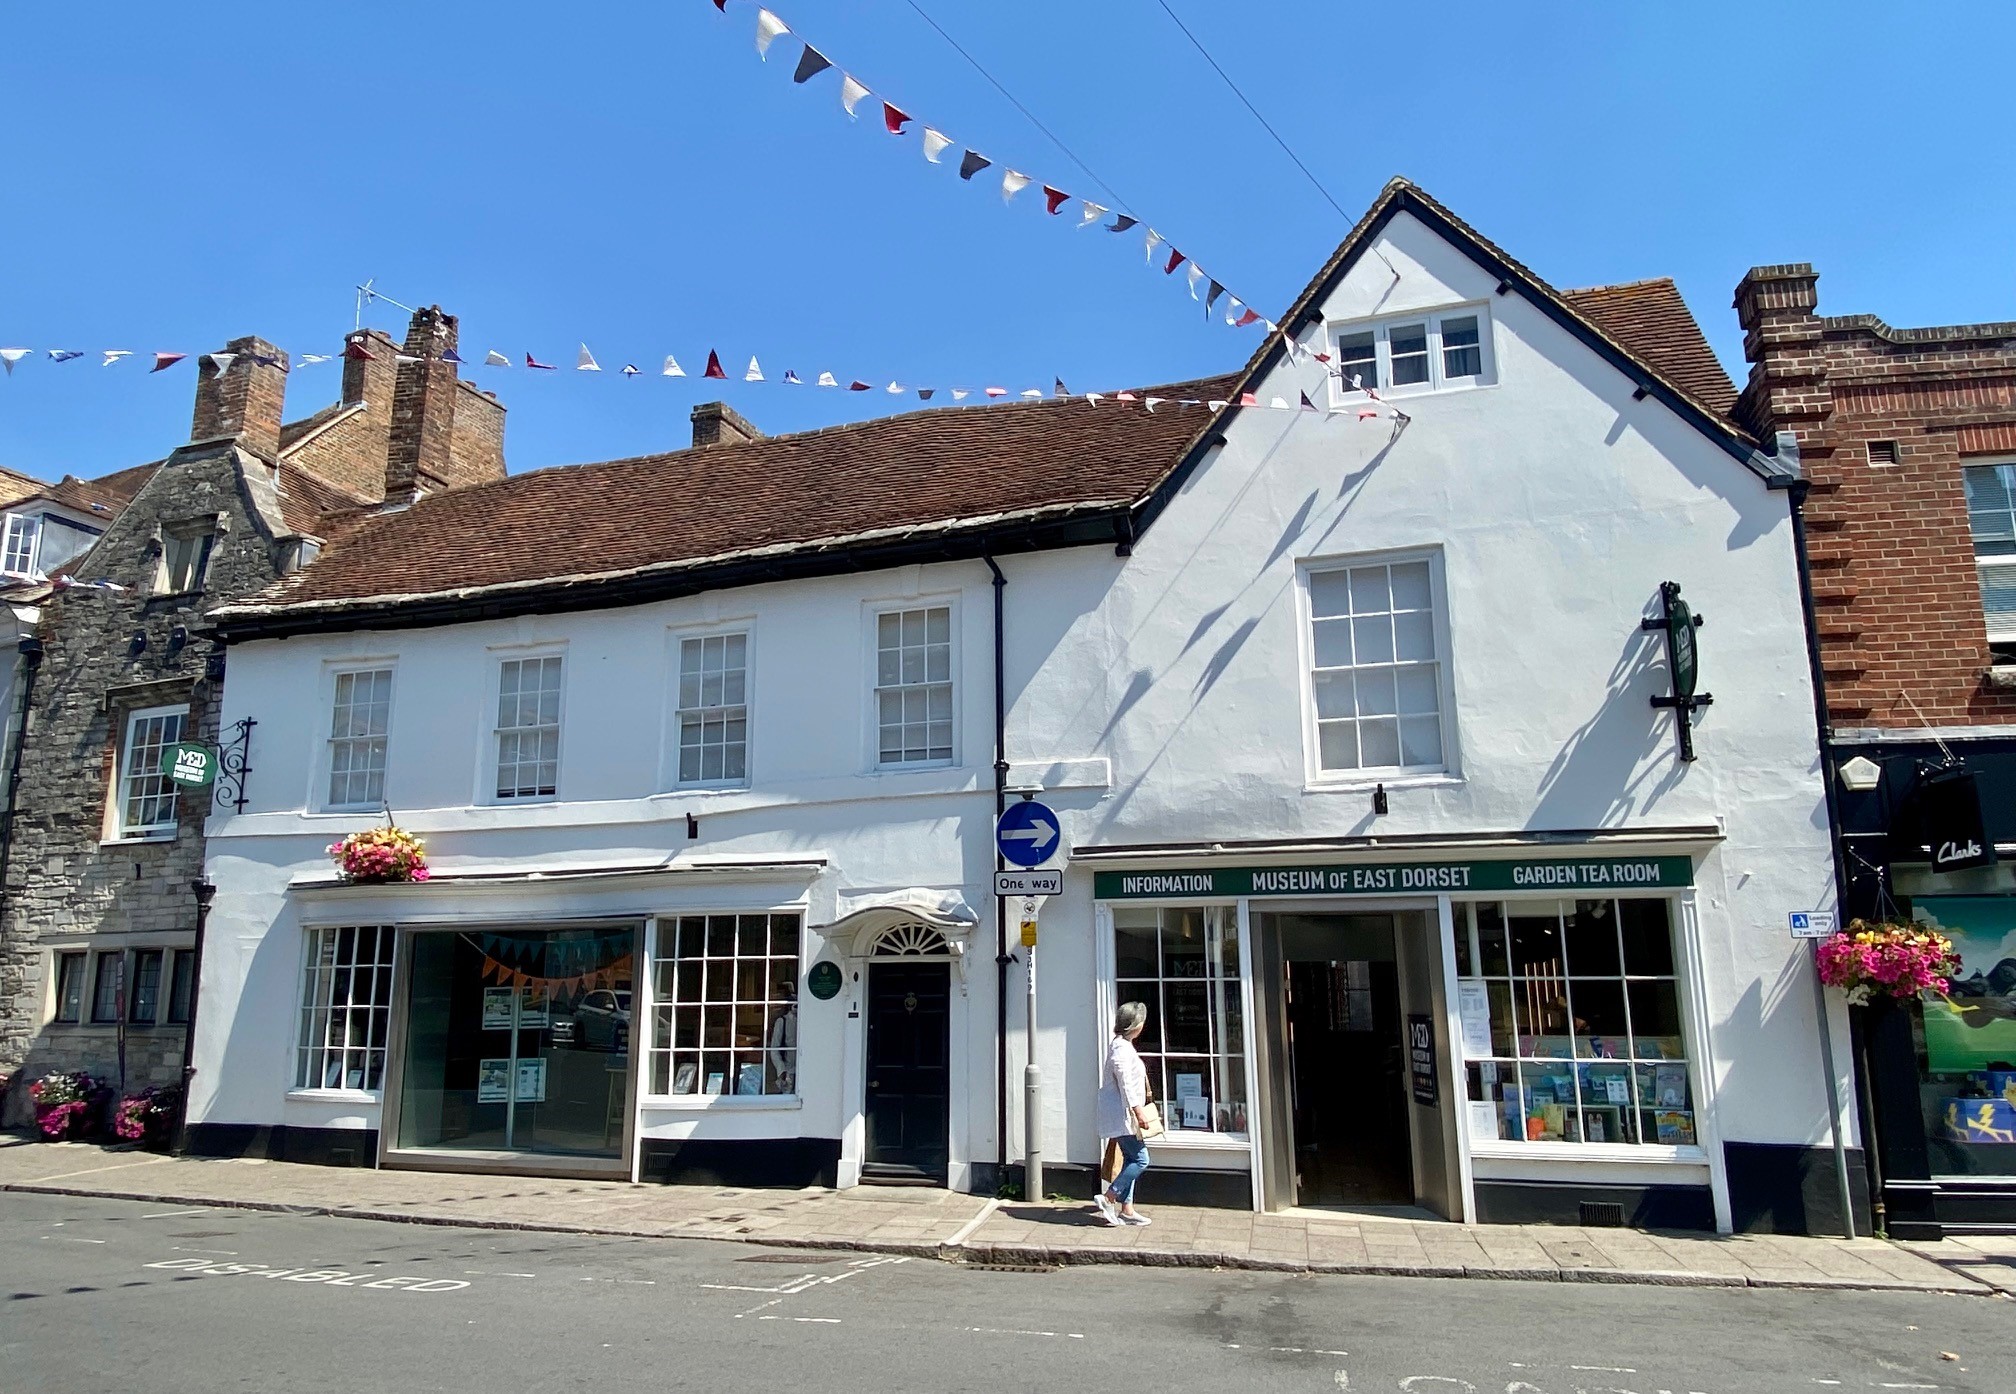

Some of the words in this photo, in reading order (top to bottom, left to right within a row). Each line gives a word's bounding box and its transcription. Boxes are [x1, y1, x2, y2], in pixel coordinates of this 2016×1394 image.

[176, 749, 207, 768] MED
[1937, 839, 1983, 864] Clarks
[1000, 878, 1024, 889] One
[1031, 879, 1057, 891] way
[1122, 874, 1213, 894] INFORMATION
[1252, 870, 1325, 891] MUSEUM
[1329, 872, 1348, 889] OF
[1353, 868, 1397, 888] EAST
[1401, 866, 1471, 888] DORSET
[1513, 865, 1577, 885] GARDEN
[1578, 864, 1611, 883] TEA
[1612, 863, 1661, 883] ROOM
[142, 1258, 472, 1292] DISABLED
